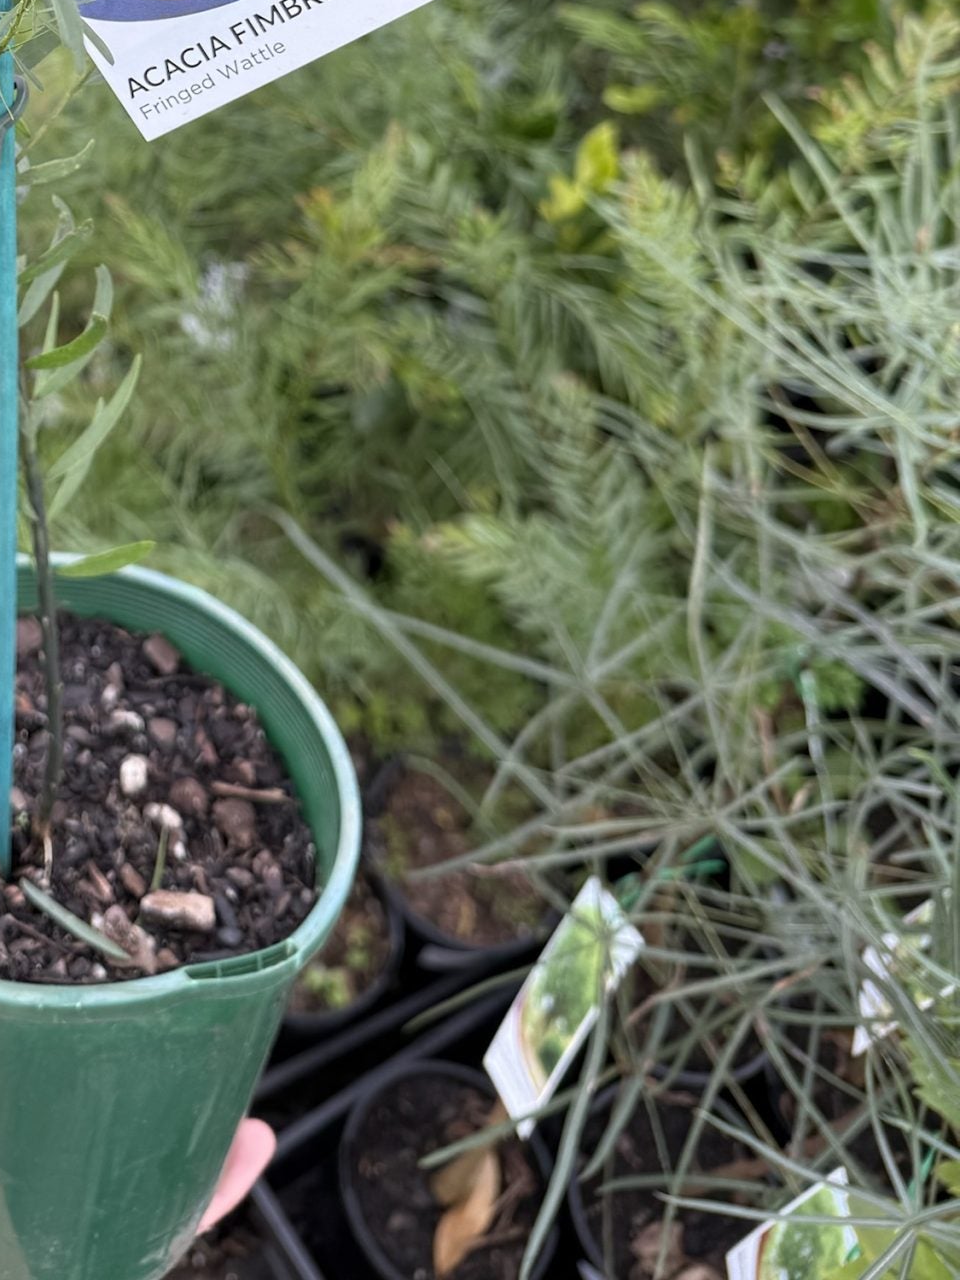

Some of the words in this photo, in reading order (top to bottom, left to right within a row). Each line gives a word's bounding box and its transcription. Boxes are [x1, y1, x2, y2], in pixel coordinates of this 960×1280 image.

[127, 35, 231, 98] ACACIA
[139, 73, 216, 120] Fringed
[217, 39, 286, 80] Wattle
